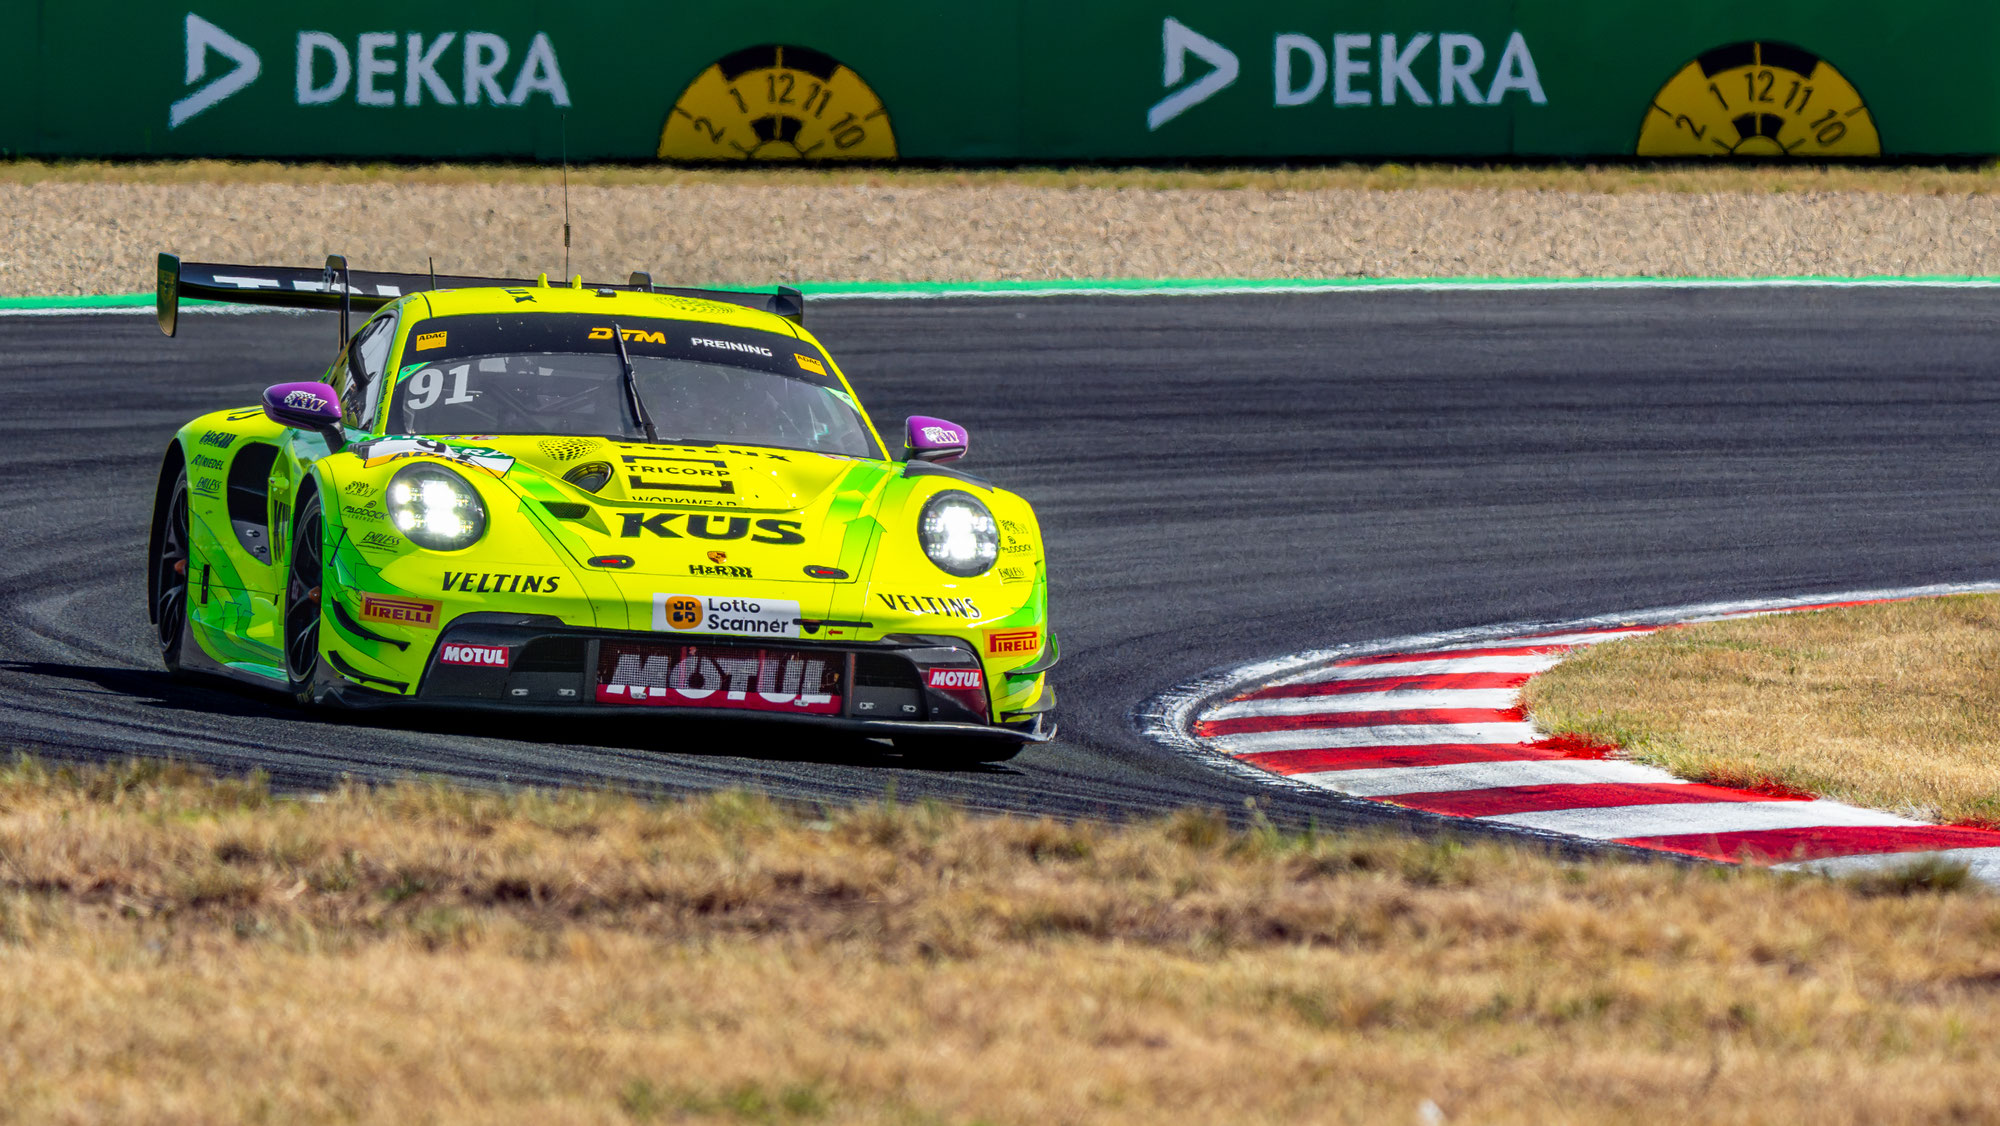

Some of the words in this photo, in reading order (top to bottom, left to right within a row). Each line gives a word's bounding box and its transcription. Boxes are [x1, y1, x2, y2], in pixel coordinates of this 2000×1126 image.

[296, 31, 572, 107] DEKRA
[1275, 31, 1548, 106] DEKRA
[694, 117, 726, 144] 2
[730, 88, 748, 114] 1
[767, 73, 796, 104] 12
[803, 82, 832, 119] 11
[829, 112, 865, 149] 10
[1676, 114, 1707, 141] 2
[1709, 83, 1729, 111] 1
[1744, 70, 1775, 103] 12
[1784, 80, 1814, 115] 11
[1810, 109, 1847, 146] 10
[418, 332, 446, 342] ADAC
[588, 328, 667, 345] DTM
[691, 337, 773, 357] PREINING
[408, 364, 474, 411] 91
[625, 465, 730, 478] TRICORP
[362, 531, 403, 546] ENDLESS
[616, 512, 806, 546] KÜS
[441, 571, 560, 593] VELTINS
[364, 597, 434, 624] PIRELLI
[708, 598, 761, 614] Lotto
[876, 592, 981, 619] VELTINS
[708, 613, 789, 634] Scanner
[989, 631, 1038, 653] PIRELLI
[443, 645, 505, 665] MOTUL
[605, 653, 832, 704] MOTUL
[930, 671, 980, 688] MOTUL
